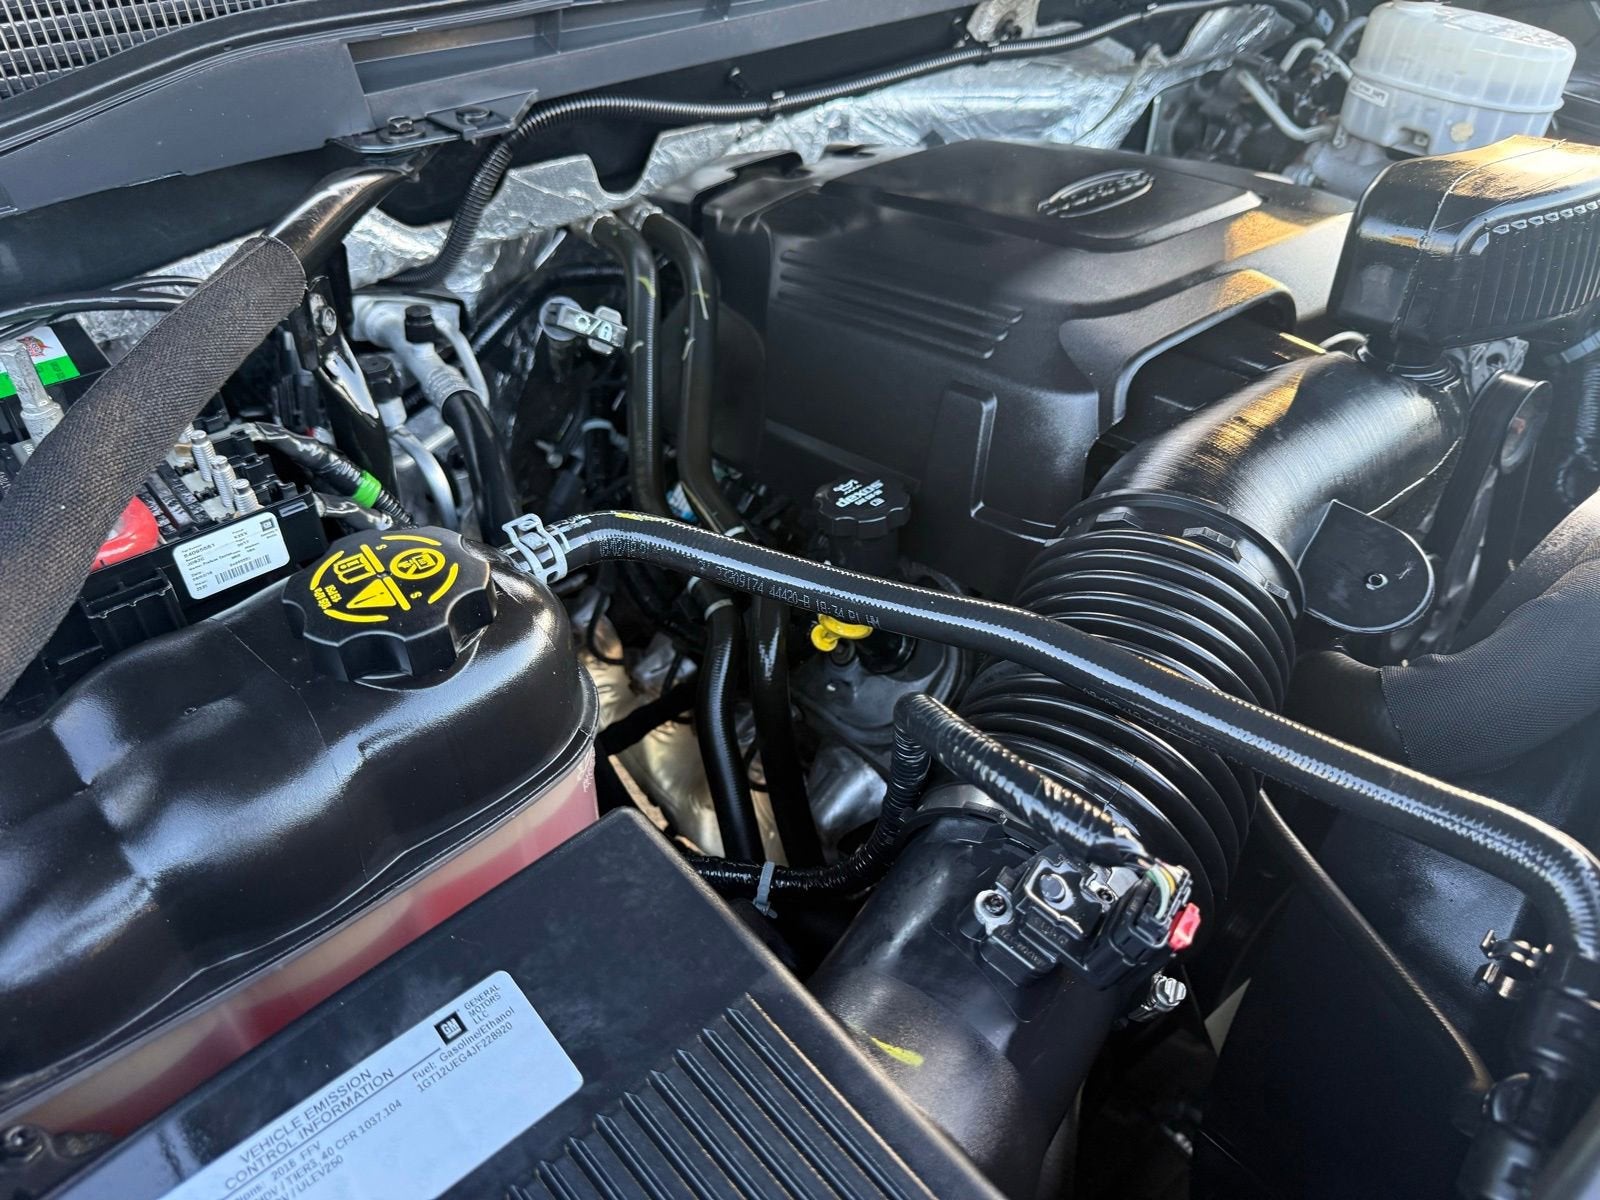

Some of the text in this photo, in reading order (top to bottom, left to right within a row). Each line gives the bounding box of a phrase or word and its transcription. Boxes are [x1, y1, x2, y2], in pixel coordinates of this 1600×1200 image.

[463, 984, 501, 1010] GENERAL
[467, 992, 502, 1017] MOTORS
[470, 1010, 489, 1025] LLC
[412, 1006, 515, 1082] Fuel: Gasoline/Ethanol
[224, 1067, 395, 1190] CONTROL INFORMATION
[239, 1068, 372, 1165] VEHICLE EMISSION
[321, 1146, 335, 1160] 40
[335, 1129, 358, 1150] CFR
[358, 1099, 402, 1135] 1037.104
[299, 1141, 321, 1161] FFV
